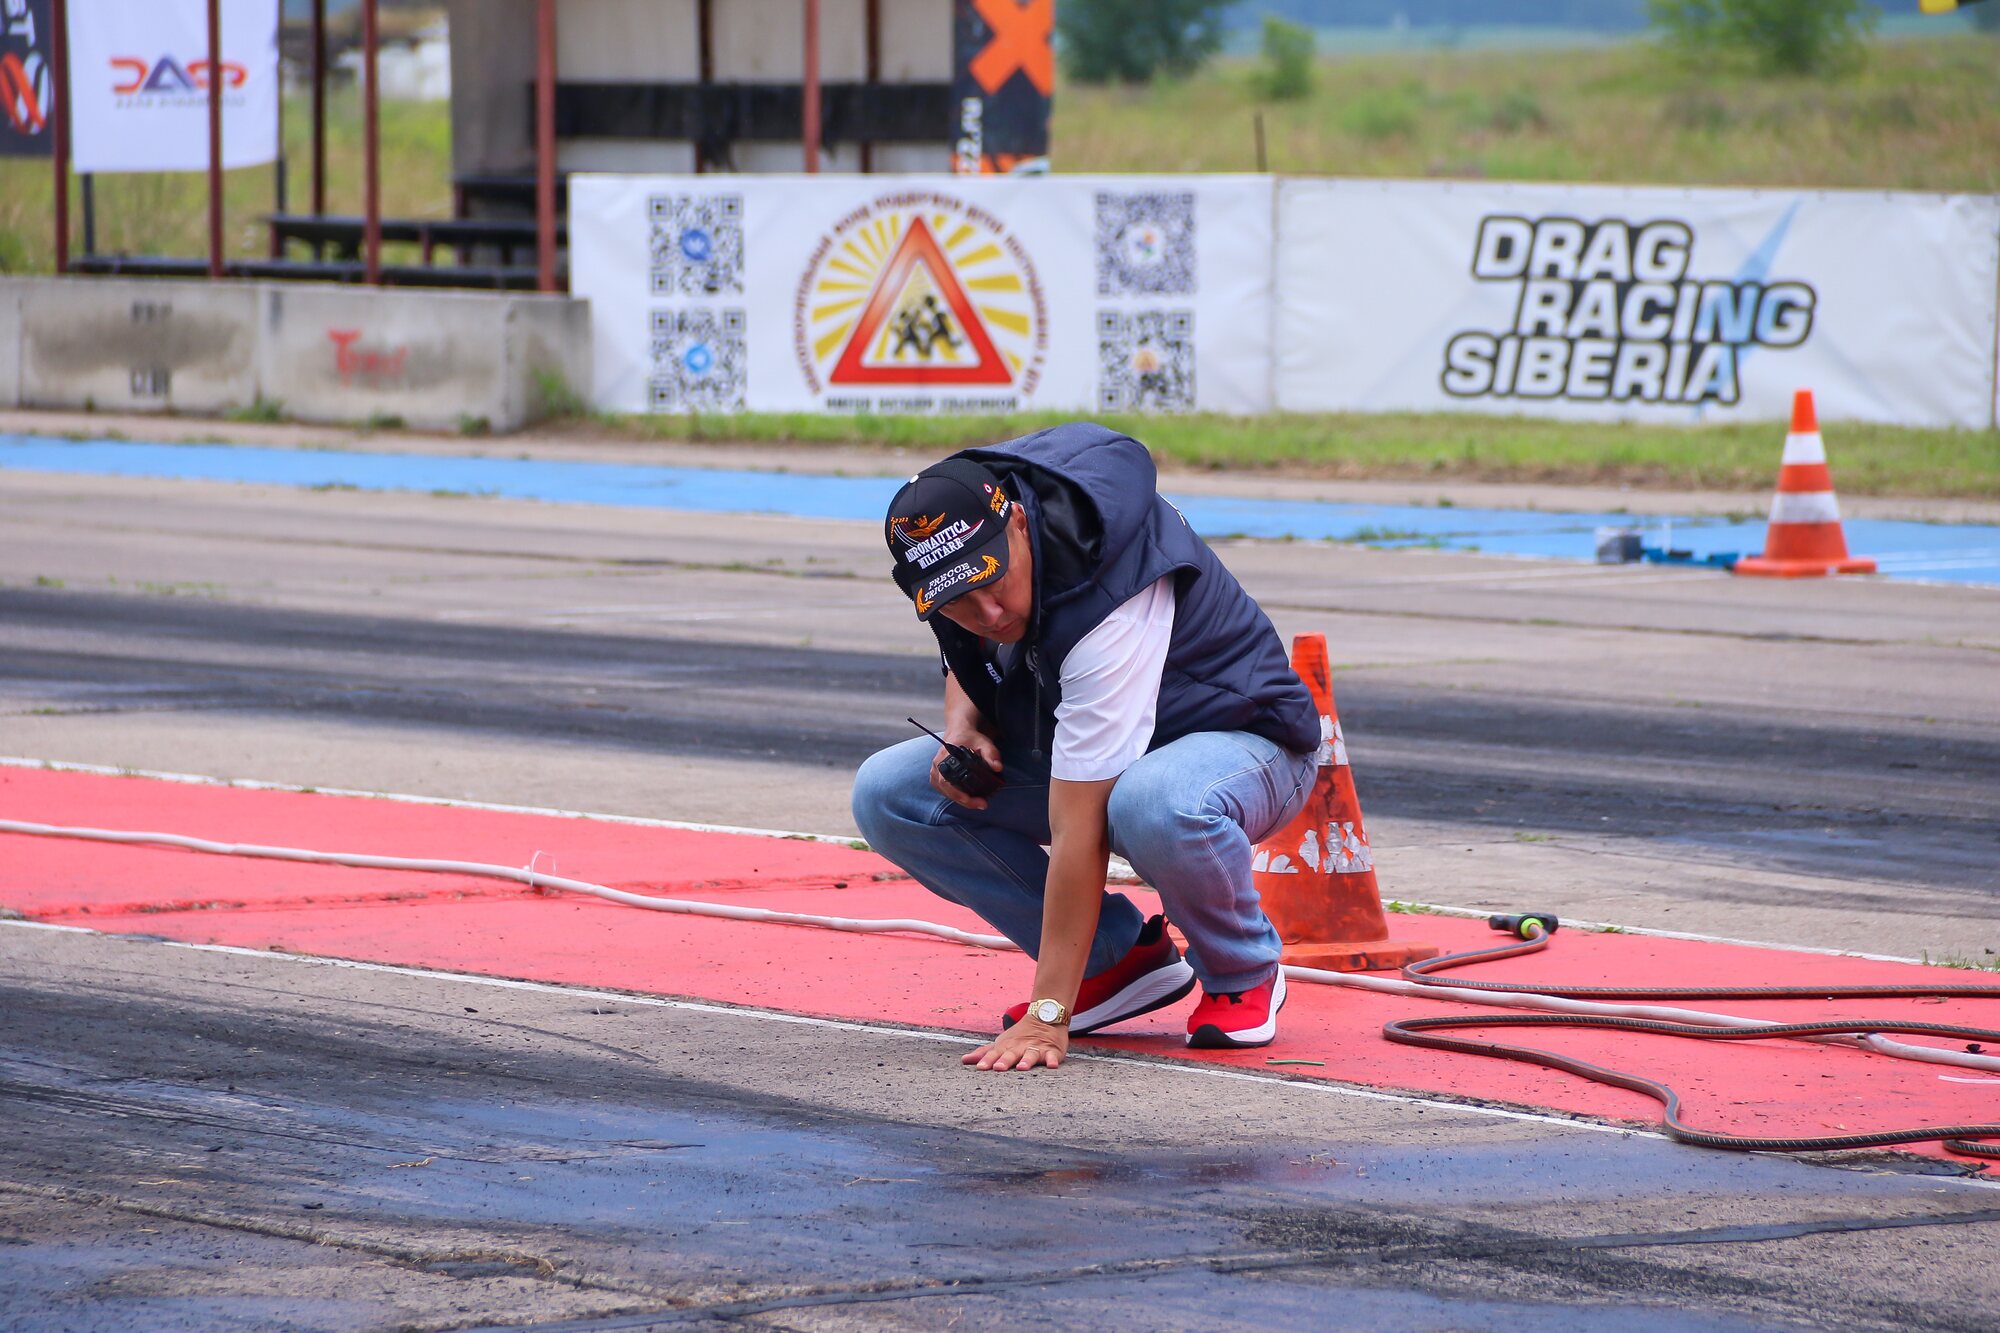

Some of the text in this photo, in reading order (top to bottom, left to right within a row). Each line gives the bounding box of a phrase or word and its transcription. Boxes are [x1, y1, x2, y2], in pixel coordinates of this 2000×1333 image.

[1472, 215, 1694, 282] DRAG
[1516, 281, 1816, 348] RACING
[1441, 332, 1740, 406] SIBERIA
[905, 519, 971, 563] AERONAUTICA
[917, 537, 965, 570] MILITARE
[924, 566, 981, 602] TRICOLORI
